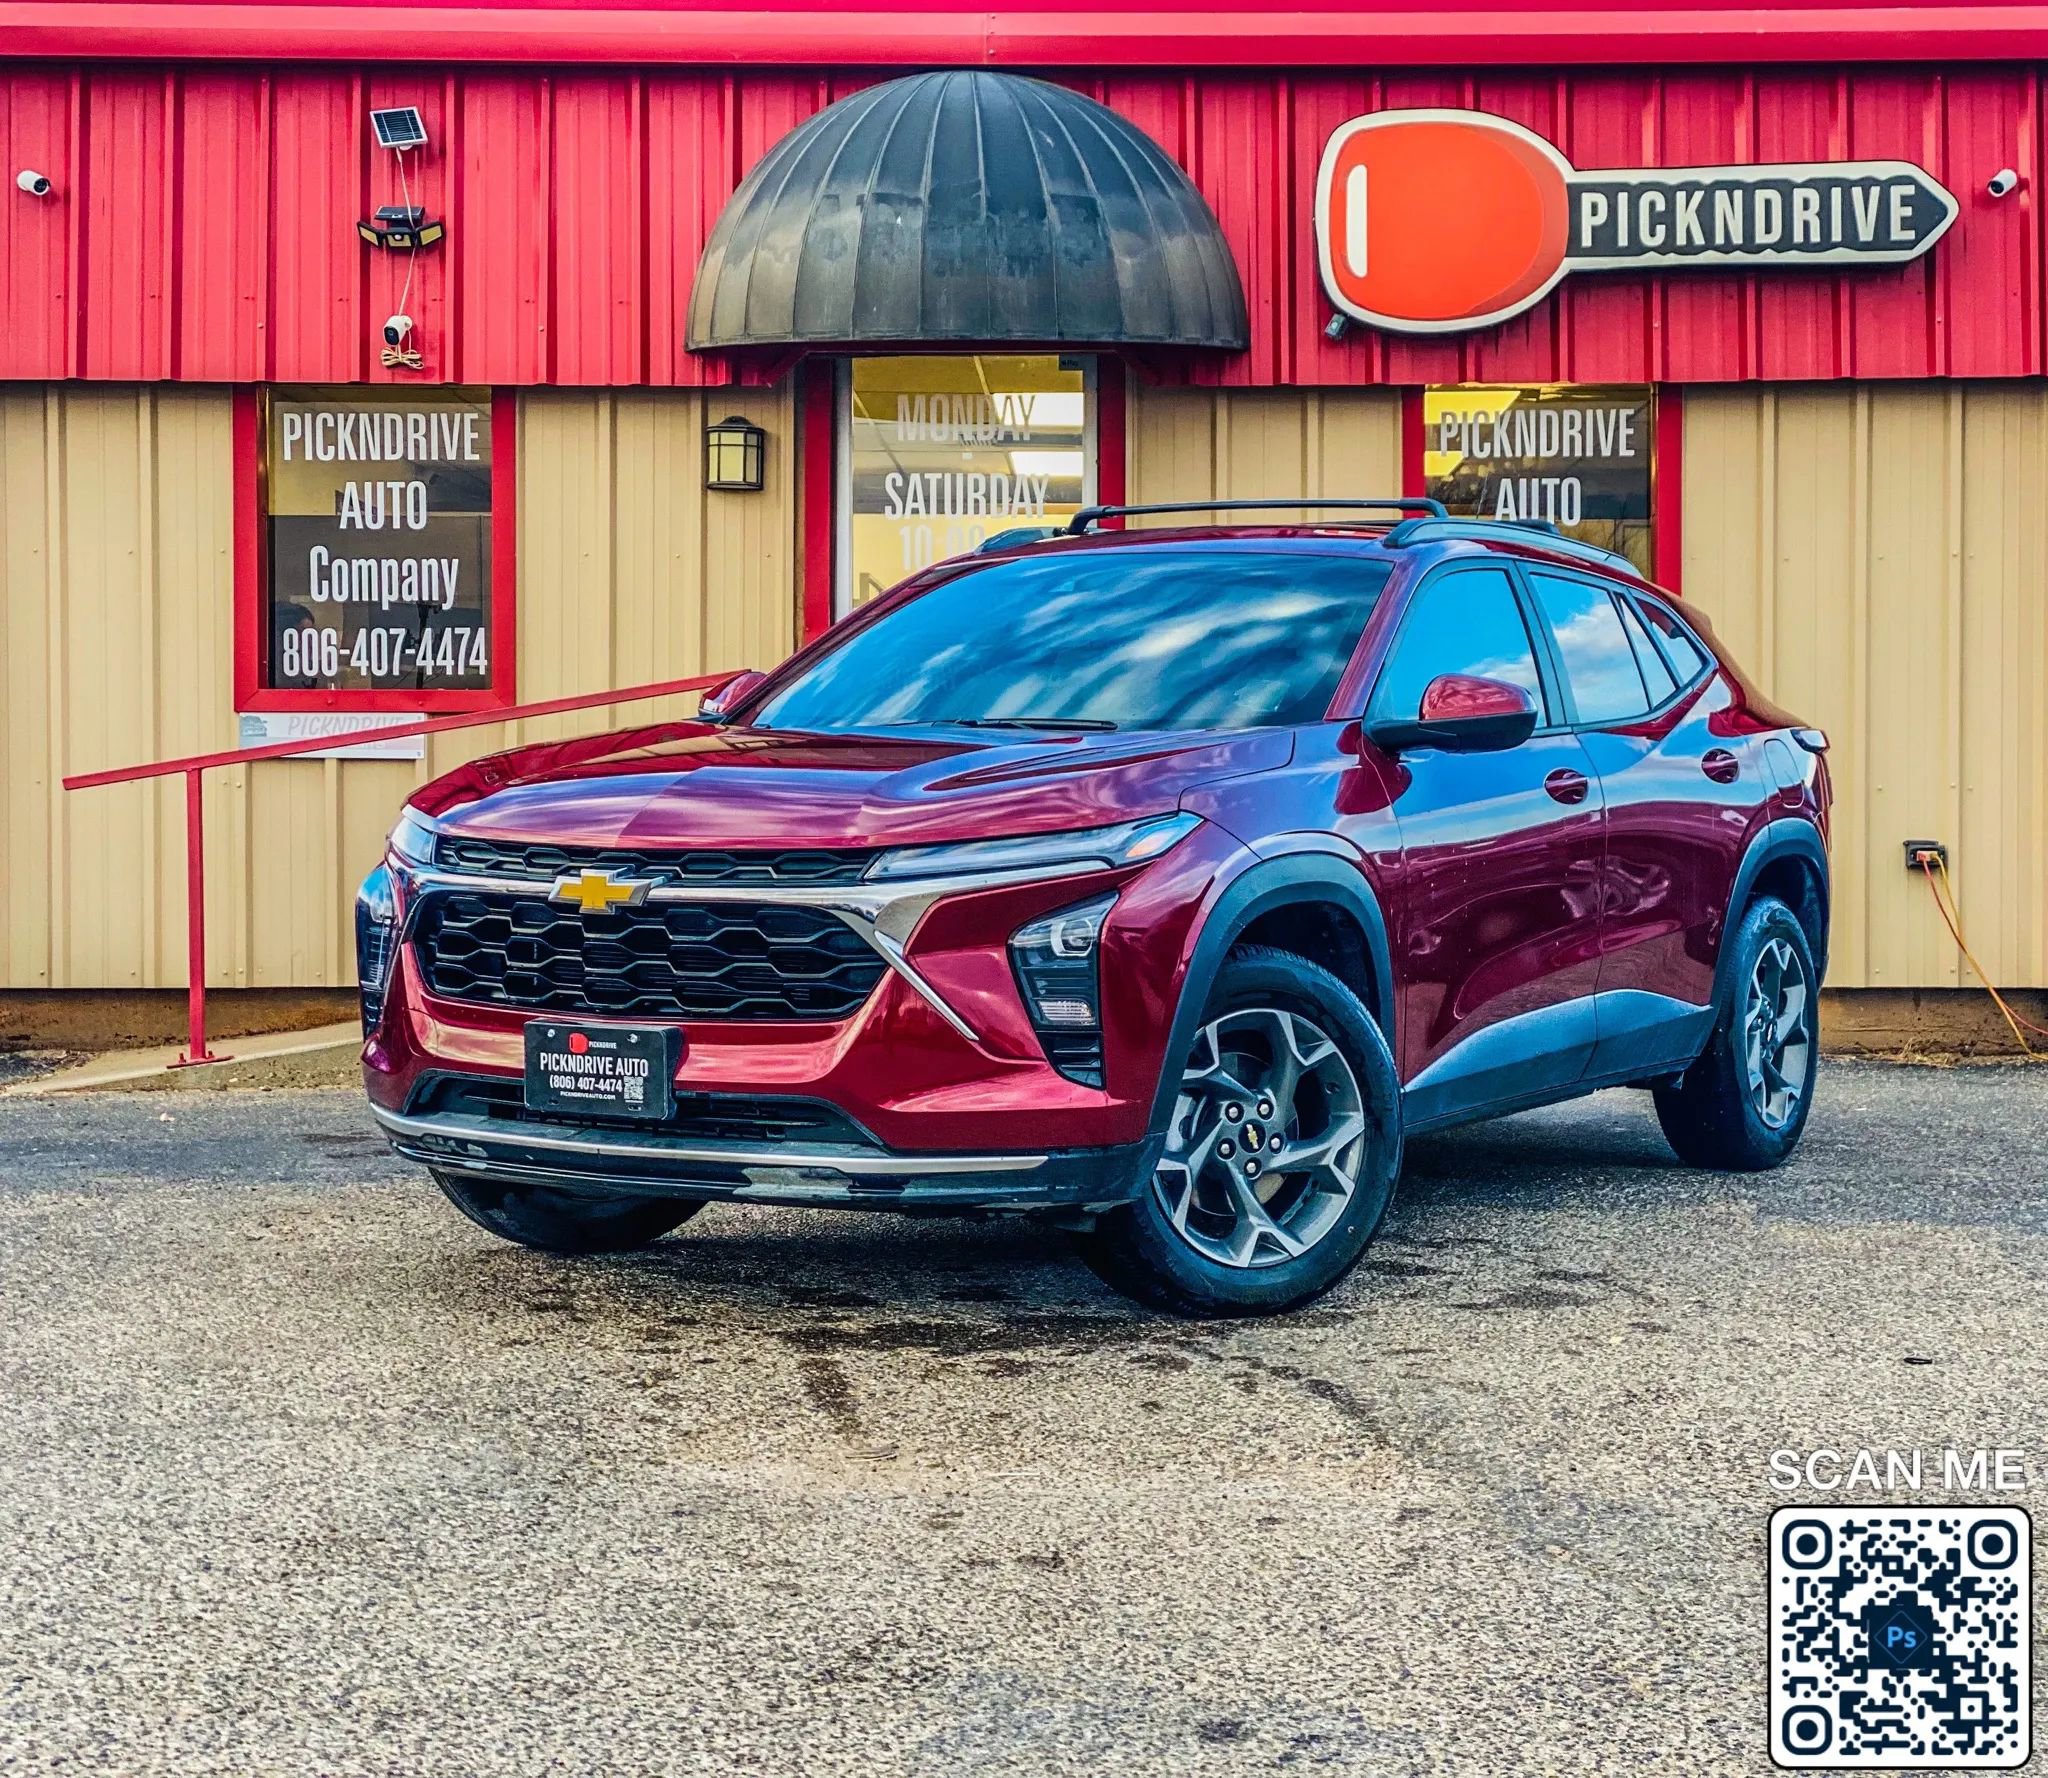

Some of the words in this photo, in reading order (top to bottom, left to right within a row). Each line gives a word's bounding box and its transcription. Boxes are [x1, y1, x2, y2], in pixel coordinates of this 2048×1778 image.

[1580, 184, 1916, 249] PICKNDRIVE
[282, 412, 480, 462] PICKNDRIVE
[896, 393, 1036, 442] MONDAY
[1440, 408, 1635, 459] PICKNDRIVE
[339, 480, 428, 530] AUTO
[884, 472, 1049, 521] SATURDAY
[1495, 476, 1582, 527] AUTO
[309, 545, 459, 611] Company
[282, 626, 488, 678] 806-407-4474
[540, 1052, 614, 1076] PICKNDRIVE
[615, 1057, 649, 1077] AUTO
[588, 1041, 617, 1049] PICKNDRIVE
[549, 1074, 575, 1090] (806)
[577, 1076, 623, 1093] 407-4474
